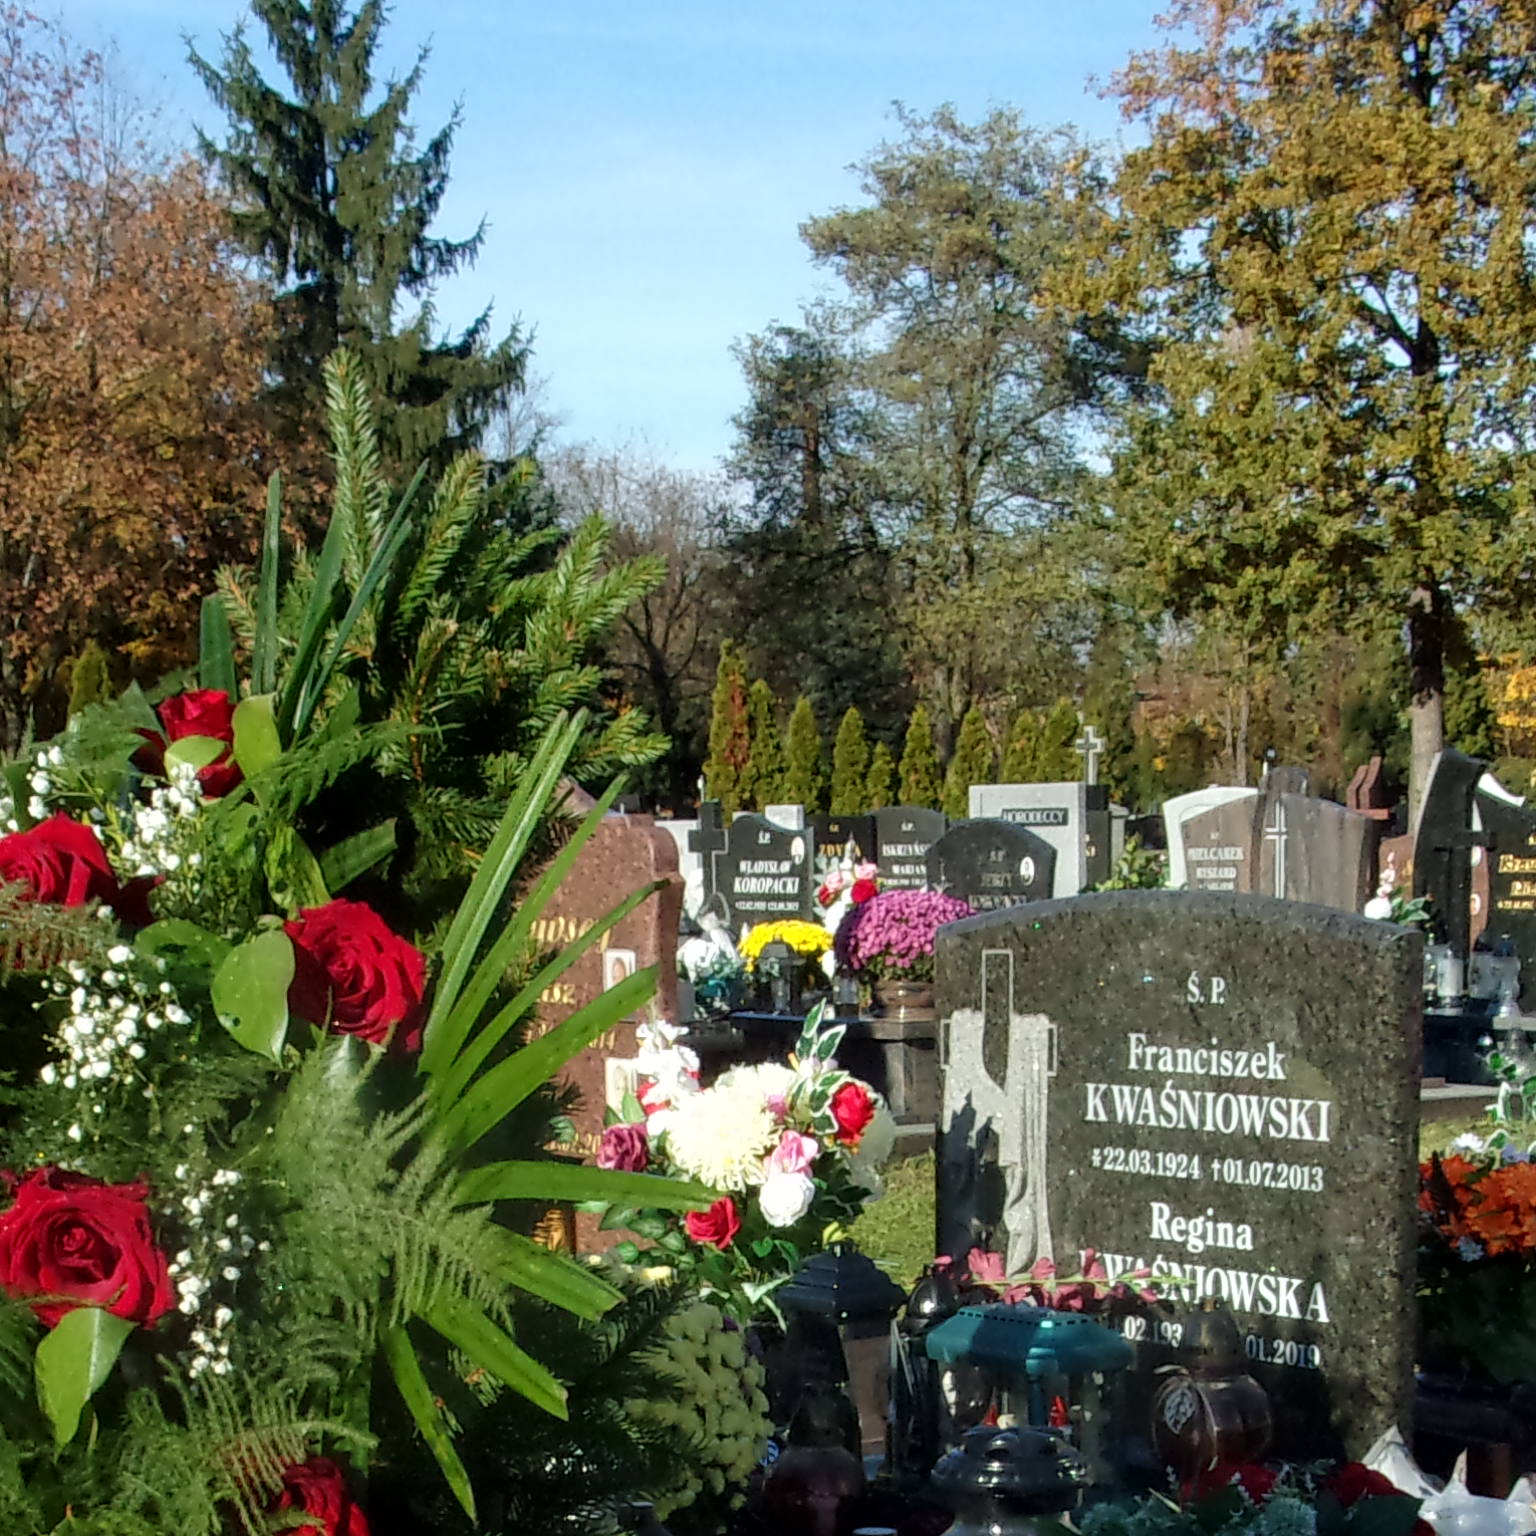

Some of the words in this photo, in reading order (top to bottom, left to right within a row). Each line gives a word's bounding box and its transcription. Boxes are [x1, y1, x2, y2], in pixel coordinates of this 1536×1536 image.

[733, 876, 801, 894] KOROPACKI
[1127, 1032, 1287, 1081] Franciszek
[1084, 1079, 1332, 1143] KWAŚNIOWSKI
[1149, 1201, 1255, 1254] Regina
